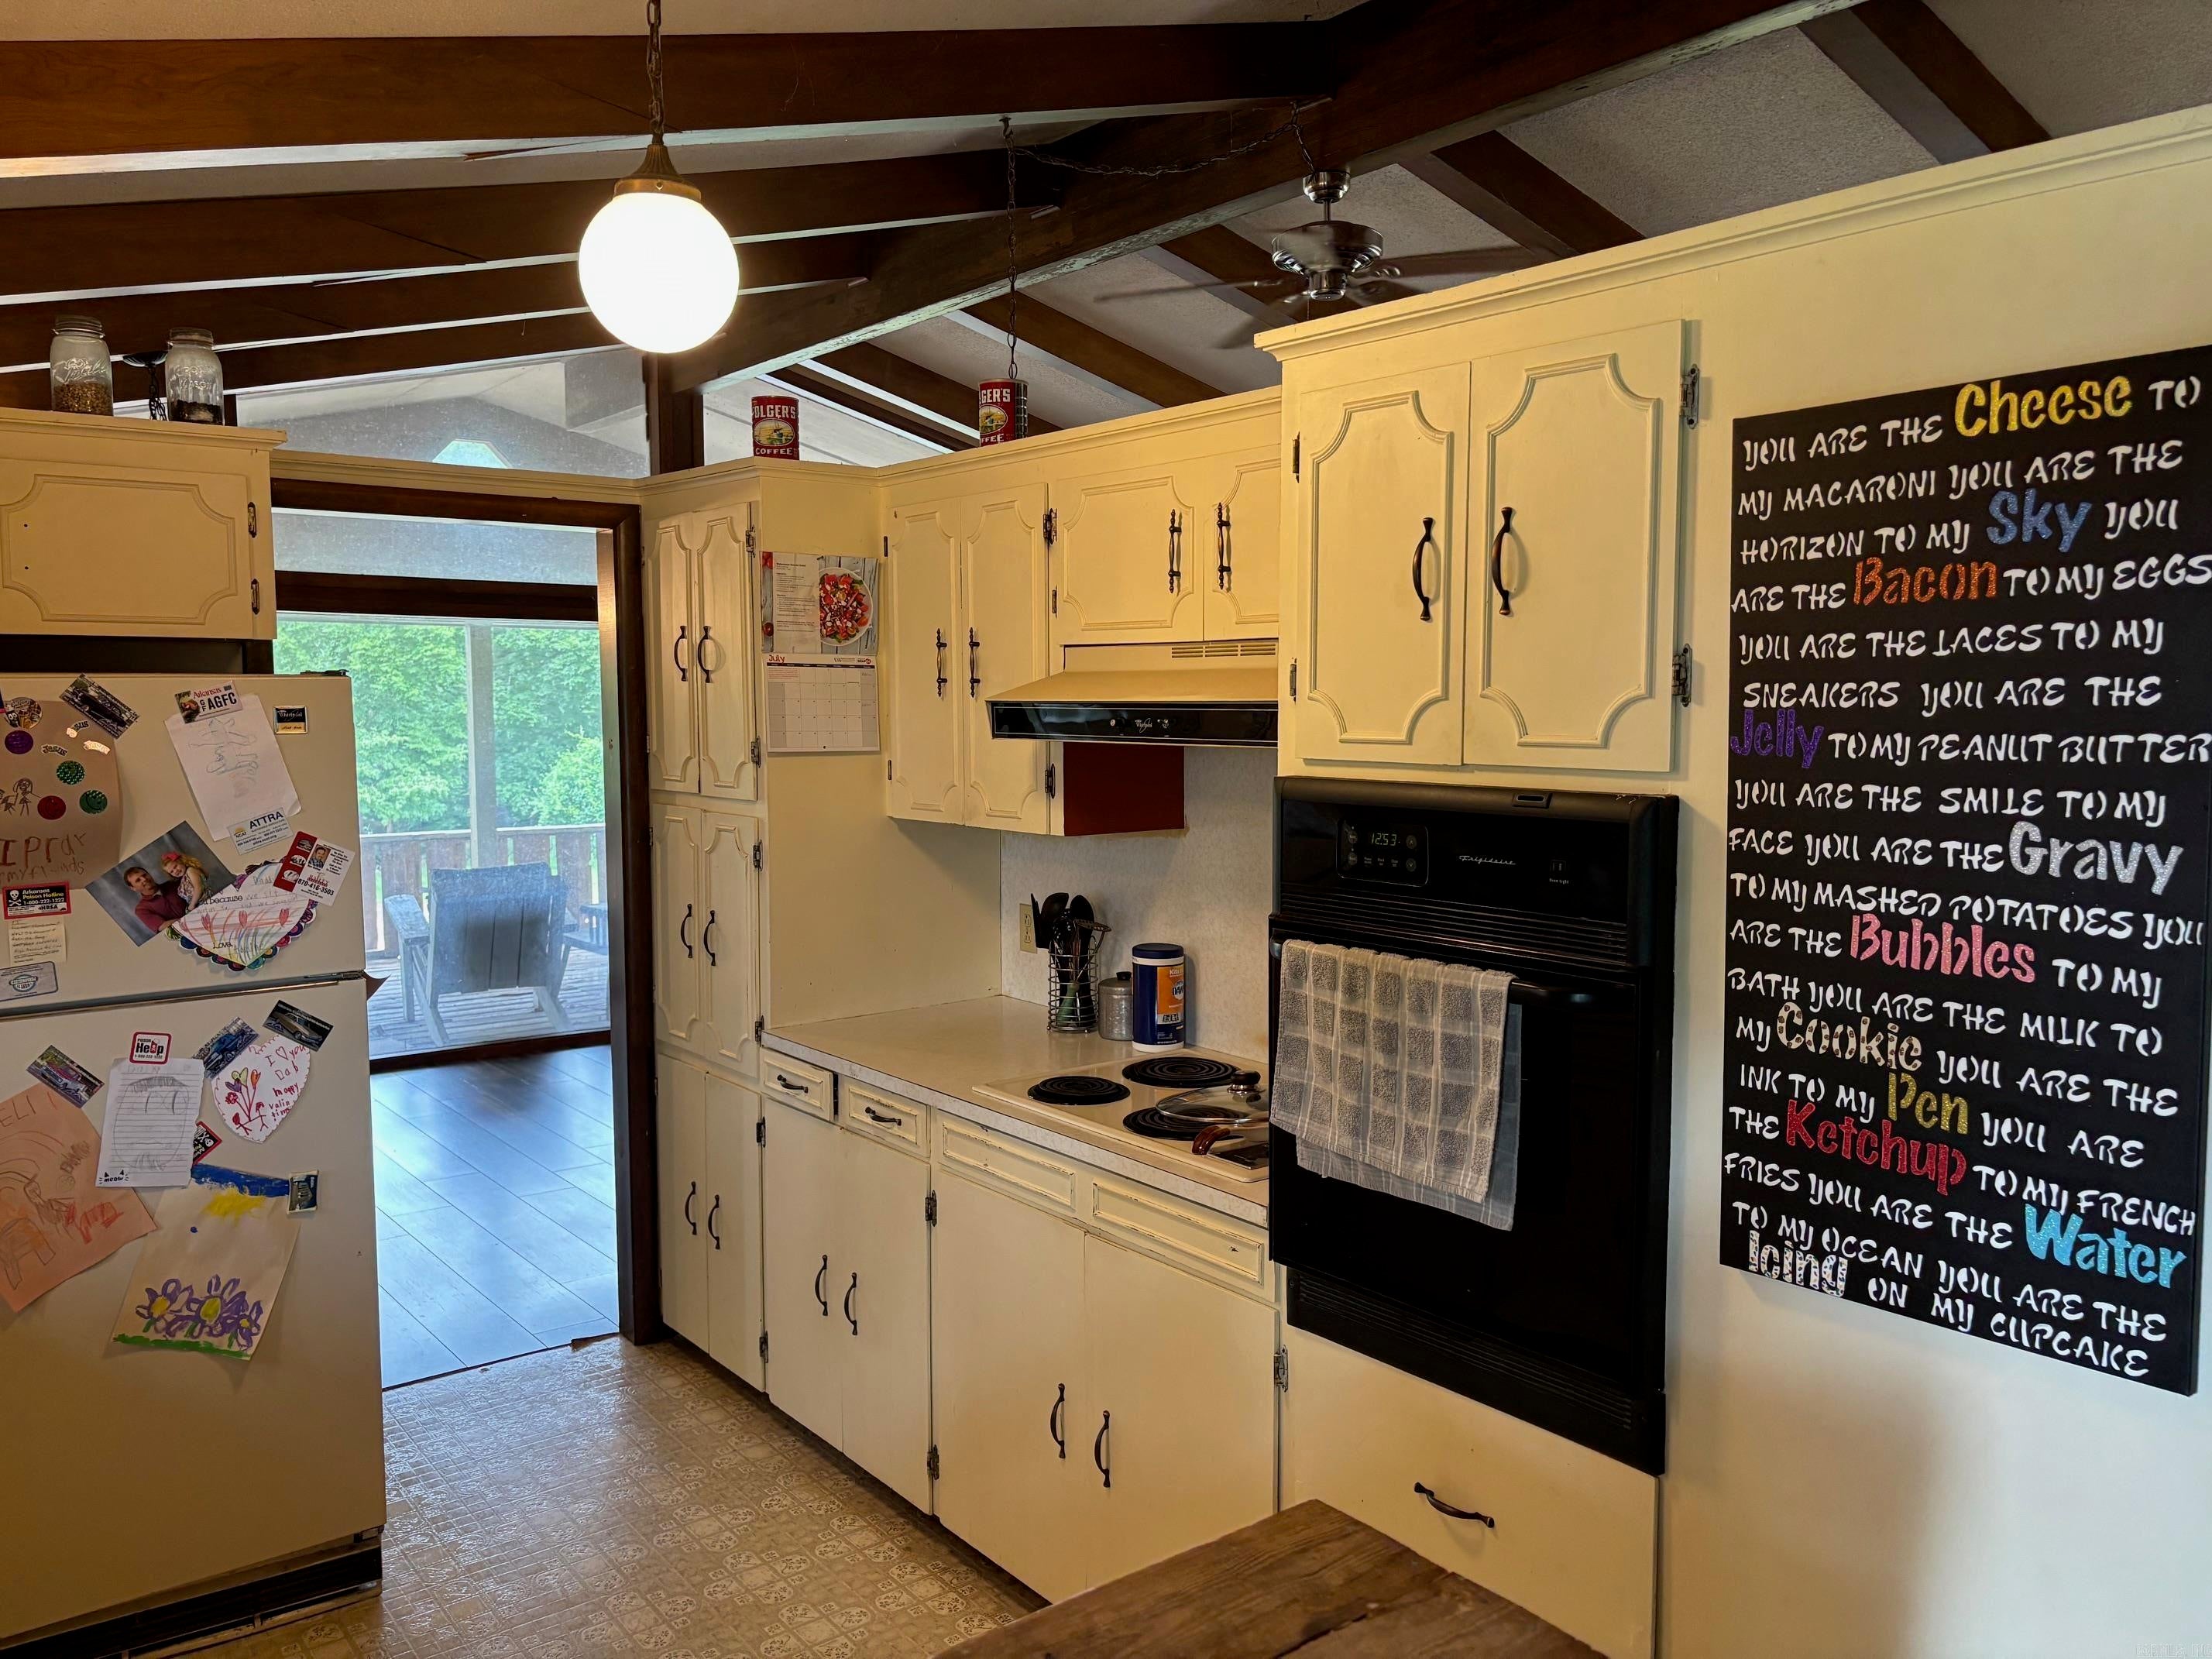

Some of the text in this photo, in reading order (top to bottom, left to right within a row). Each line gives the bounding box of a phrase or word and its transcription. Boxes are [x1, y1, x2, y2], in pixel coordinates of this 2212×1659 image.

[753, 405, 796, 418] OLGER'S
[981, 388, 1011, 404] GER'S
[1743, 376, 2200, 471] YOU ARE THE Cheese TO
[981, 434, 1004, 443] FFEE
[1738, 441, 2182, 520] MY MACARONI YOU ARE THE
[1740, 487, 2178, 564] HORIZON TO MY Sky YOU
[1732, 554, 2212, 613] ARE THE Bacon TO MY EGGS
[769, 654, 785, 664] July
[1740, 618, 2163, 665] YOU ARE THE LACES TO MY
[194, 688, 222, 699] Arkansas
[208, 692, 237, 710] AGFC
[1743, 676, 2161, 717] SNEAKERS YOU ARE THE
[1730, 709, 2212, 768] Jelly TO MY PEANUT BUTTER
[250, 812, 283, 829] ATTRA
[1736, 780, 2166, 827] YOU ARE THE SMILE TO MY
[1459, 855, 1516, 864] Frigidaire
[1729, 820, 2184, 895] FACE YOU ARE THE Gravy
[1730, 873, 2203, 950] TO MY MASHED POTATOES YOU
[1730, 912, 2161, 1008] ARE THE Bubbles TO MY
[1728, 968, 2162, 1056] BATH YOU ARE THE MILK TO
[290, 1045, 306, 1059] you
[1736, 1001, 2178, 1116] MY Cookie YOU ARE THE
[1741, 1064, 2144, 1167] INK TO MY Pen YOU ARE
[1729, 1101, 2195, 1235] THE Ketchup TO MY FRENCH
[1725, 1153, 2187, 1289] FRIES YOU ARE THE Water
[1733, 1202, 2166, 1341] TO MY OCEAN YOU ARE THE
[1747, 1231, 2148, 1376] Icing ON MY CUPCAKE
